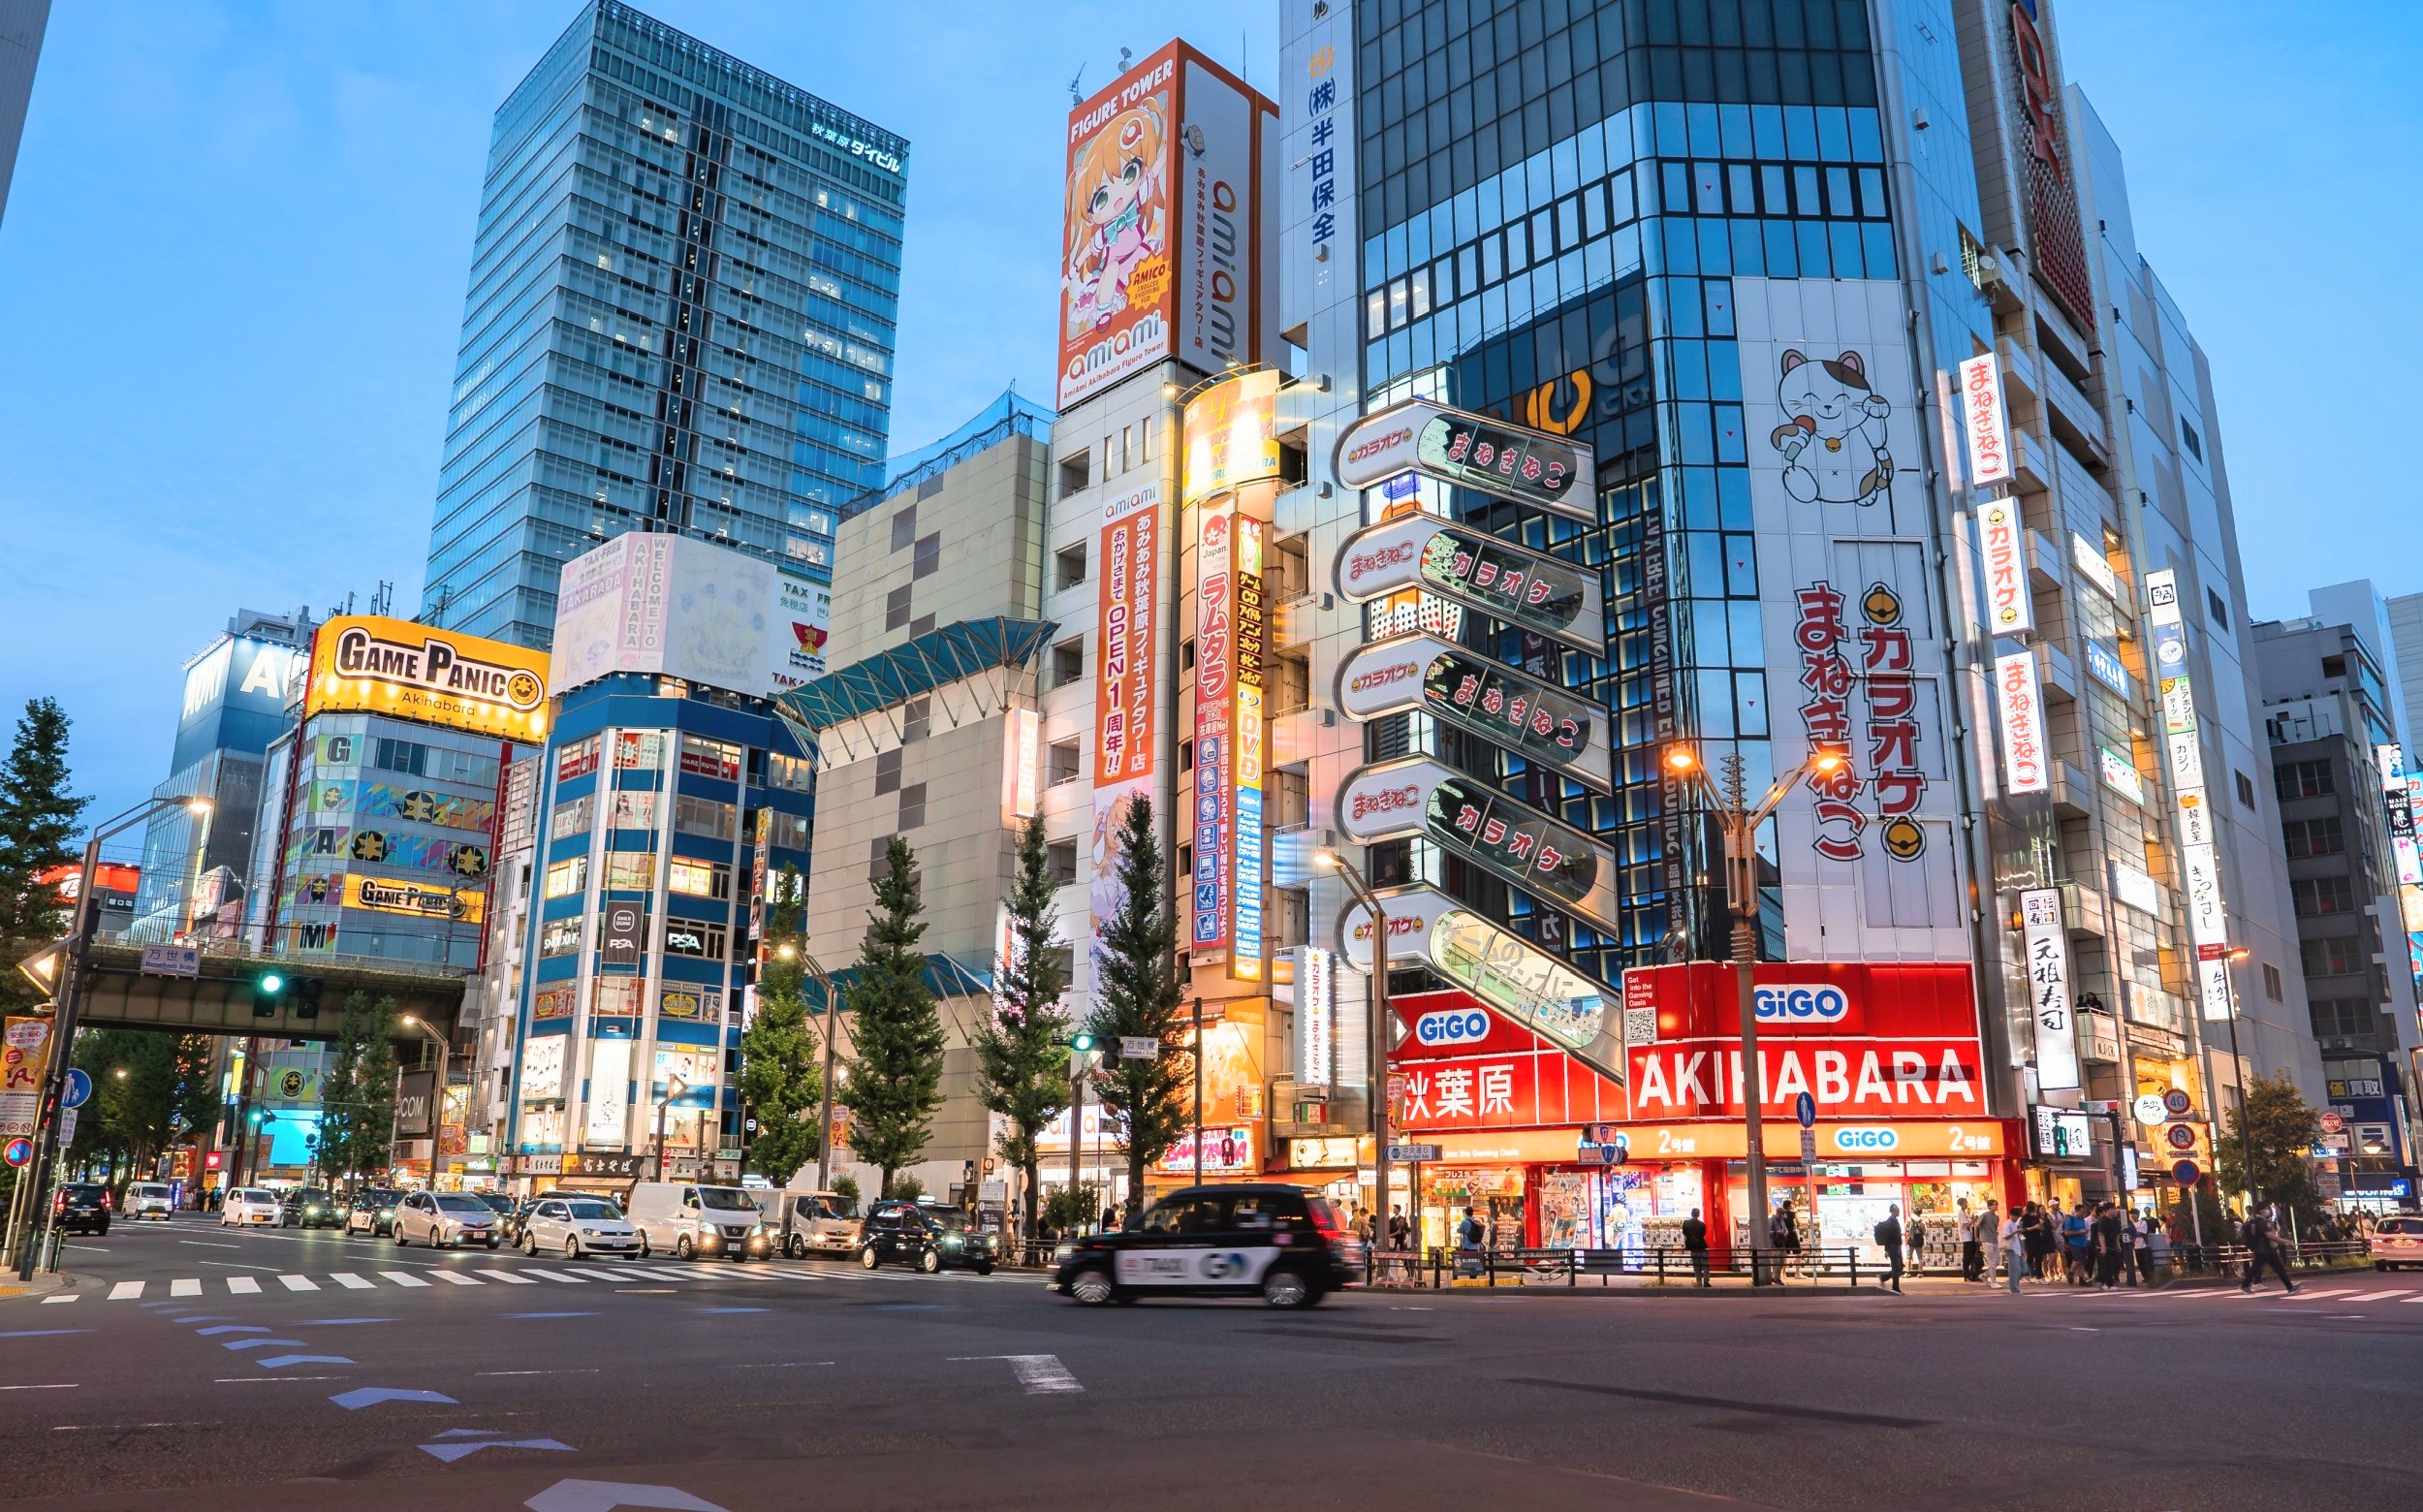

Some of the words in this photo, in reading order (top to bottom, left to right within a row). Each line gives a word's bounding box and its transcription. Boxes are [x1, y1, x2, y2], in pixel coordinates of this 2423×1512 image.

[1071, 95, 1118, 143] FIGURE
[1121, 59, 1174, 109] TOWER
[812, 123, 900, 173] 秋葉原ダイビル
[1308, 78, 1336, 245] (株)半田保全
[1133, 264, 1166, 286] AMICO
[1134, 286, 1161, 299] SHOPPING
[1069, 309, 1161, 380] amiami
[1063, 386, 1087, 399] AmiAmi
[1088, 364, 1121, 387] Akihabara
[1122, 352, 1144, 369] Figure
[1145, 341, 1164, 357] Tower
[1969, 361, 2002, 476] まねきねこ
[1356, 427, 1403, 459] カラオケ
[1448, 432, 1565, 488] まねきねこ
[1105, 486, 1156, 519] amiami
[583, 539, 622, 568] TAX-FREE
[1113, 529, 1126, 600] おかげさまで
[1203, 545, 1229, 559] Japan.
[1350, 540, 1415, 582] まねきねこ
[1988, 525, 2018, 607] カラオケ
[648, 537, 670, 617] WELCOME
[783, 583, 808, 599] TAX
[1241, 574, 1261, 591] ゲーム
[1451, 550, 1552, 604] カラオケ
[560, 575, 621, 610] TAKARADA
[623, 543, 647, 648] AKIHABARA
[779, 595, 808, 614] 免税店
[1242, 590, 1259, 605] CD
[1239, 619, 1261, 637] アニメ
[1240, 606, 1261, 621] アイドル
[644, 623, 659, 648] TO
[1107, 606, 1126, 678] OPEN
[1131, 513, 1151, 772] あみあみ秋葉原フィギュアタワー店
[1201, 574, 1229, 697] ラムタラ
[1240, 637, 1260, 652] コミック
[341, 626, 420, 678] GAME
[426, 639, 506, 692] PANIC
[1241, 654, 1260, 667] ホビー
[1240, 669, 1261, 685] フィギュア
[1359, 663, 1408, 690] カラオケ
[402, 691, 476, 716] Akihabara
[1454, 675, 1579, 747] まねきねこ
[1795, 582, 1867, 863] まねきねこ
[1859, 627, 1926, 818] カラオケ
[2003, 659, 2039, 786] まねきねこ
[1241, 712, 1260, 780] DVD
[2176, 744, 2189, 772] カジノ
[1352, 784, 1421, 822] まねきねこ
[1456, 803, 1562, 871] カラオケ
[361, 880, 402, 905] GAME
[668, 932, 703, 950] PSA
[1363, 915, 1415, 941] カオケ
[148, 950, 196, 961] 万世橋
[610, 938, 635, 949] PSA
[1628, 991, 1653, 1001] Gaming
[2032, 937, 2063, 1030] 元祖寿司
[1754, 989, 1843, 1018] GiGO
[1419, 1012, 1488, 1041] GiGO
[1637, 1048, 1975, 1108] AKIHABARA
[2349, 1080, 2380, 1096] 買取
[1403, 1064, 1515, 1122] 秋葉原
[2170, 1095, 2186, 1107] 40
[1658, 1129, 1696, 1154] 2号館
[1837, 1129, 1896, 1148] GiGO
[1949, 1126, 1991, 1151] 2号館
[583, 1157, 633, 1173] 富士そば
[1460, 1150, 1471, 1158] the
[1471, 1150, 1499, 1158] Gaming
